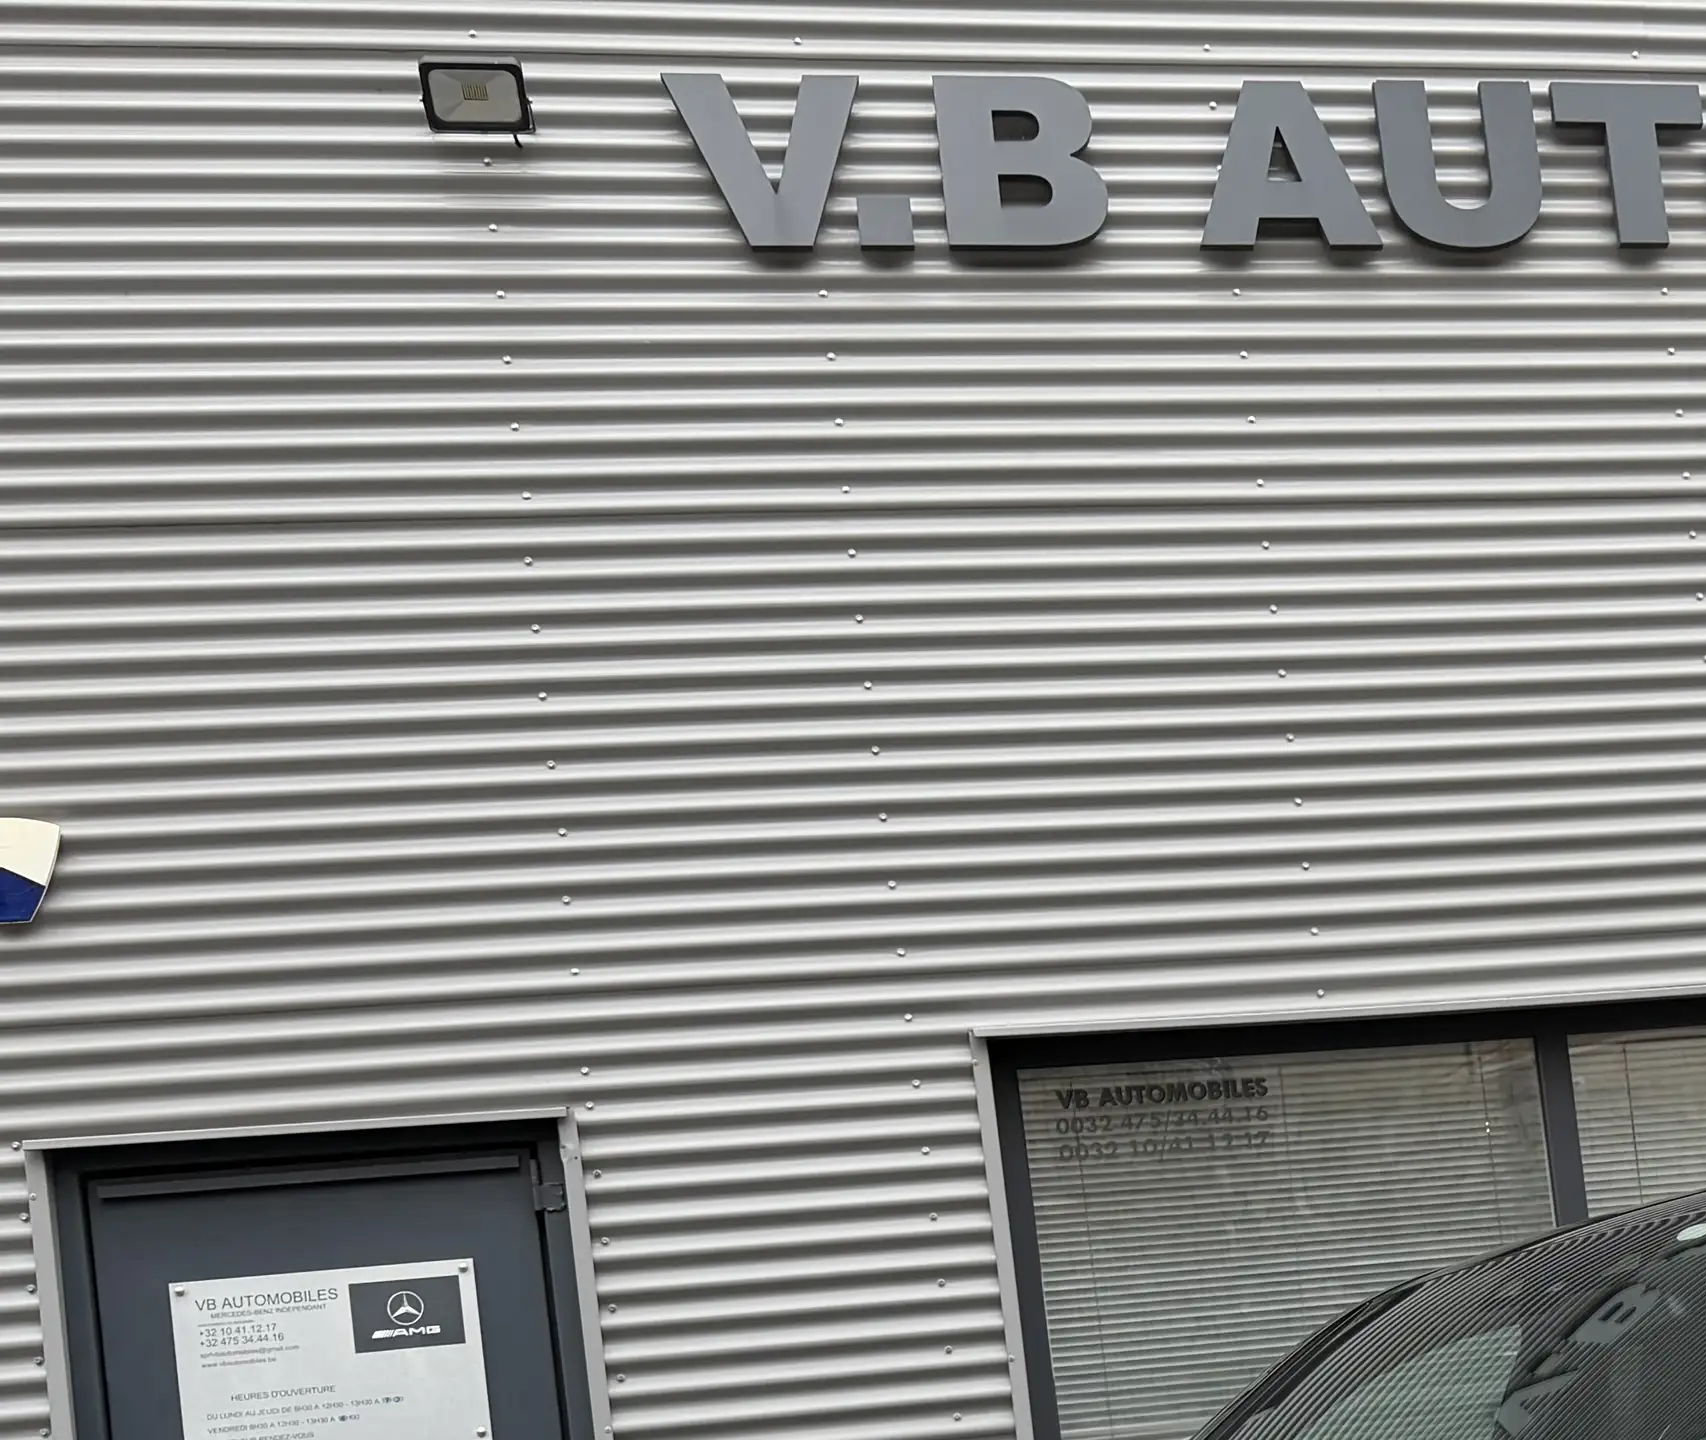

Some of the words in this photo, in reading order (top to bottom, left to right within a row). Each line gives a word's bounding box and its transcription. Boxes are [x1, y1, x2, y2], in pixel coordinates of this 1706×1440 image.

[661, 73, 1109, 248] V.B
[1055, 1088, 1090, 1110] VB
[1100, 1077, 1269, 1107] AUTOMOBILES
[1056, 1115, 1112, 1135] 0032
[1058, 1141, 1118, 1162] 0032
[195, 1298, 217, 1312] VB
[221, 1288, 338, 1310] AUTOMOBILES
[220, 1326, 233, 1336] 10
[233, 1323, 277, 1335] 41.12.17
[219, 1335, 240, 1345] 475
[231, 1392, 269, 1402] HEURES
[271, 1385, 336, 1399] D'OUVERTURE
[207, 1425, 247, 1435] VENDREDI
